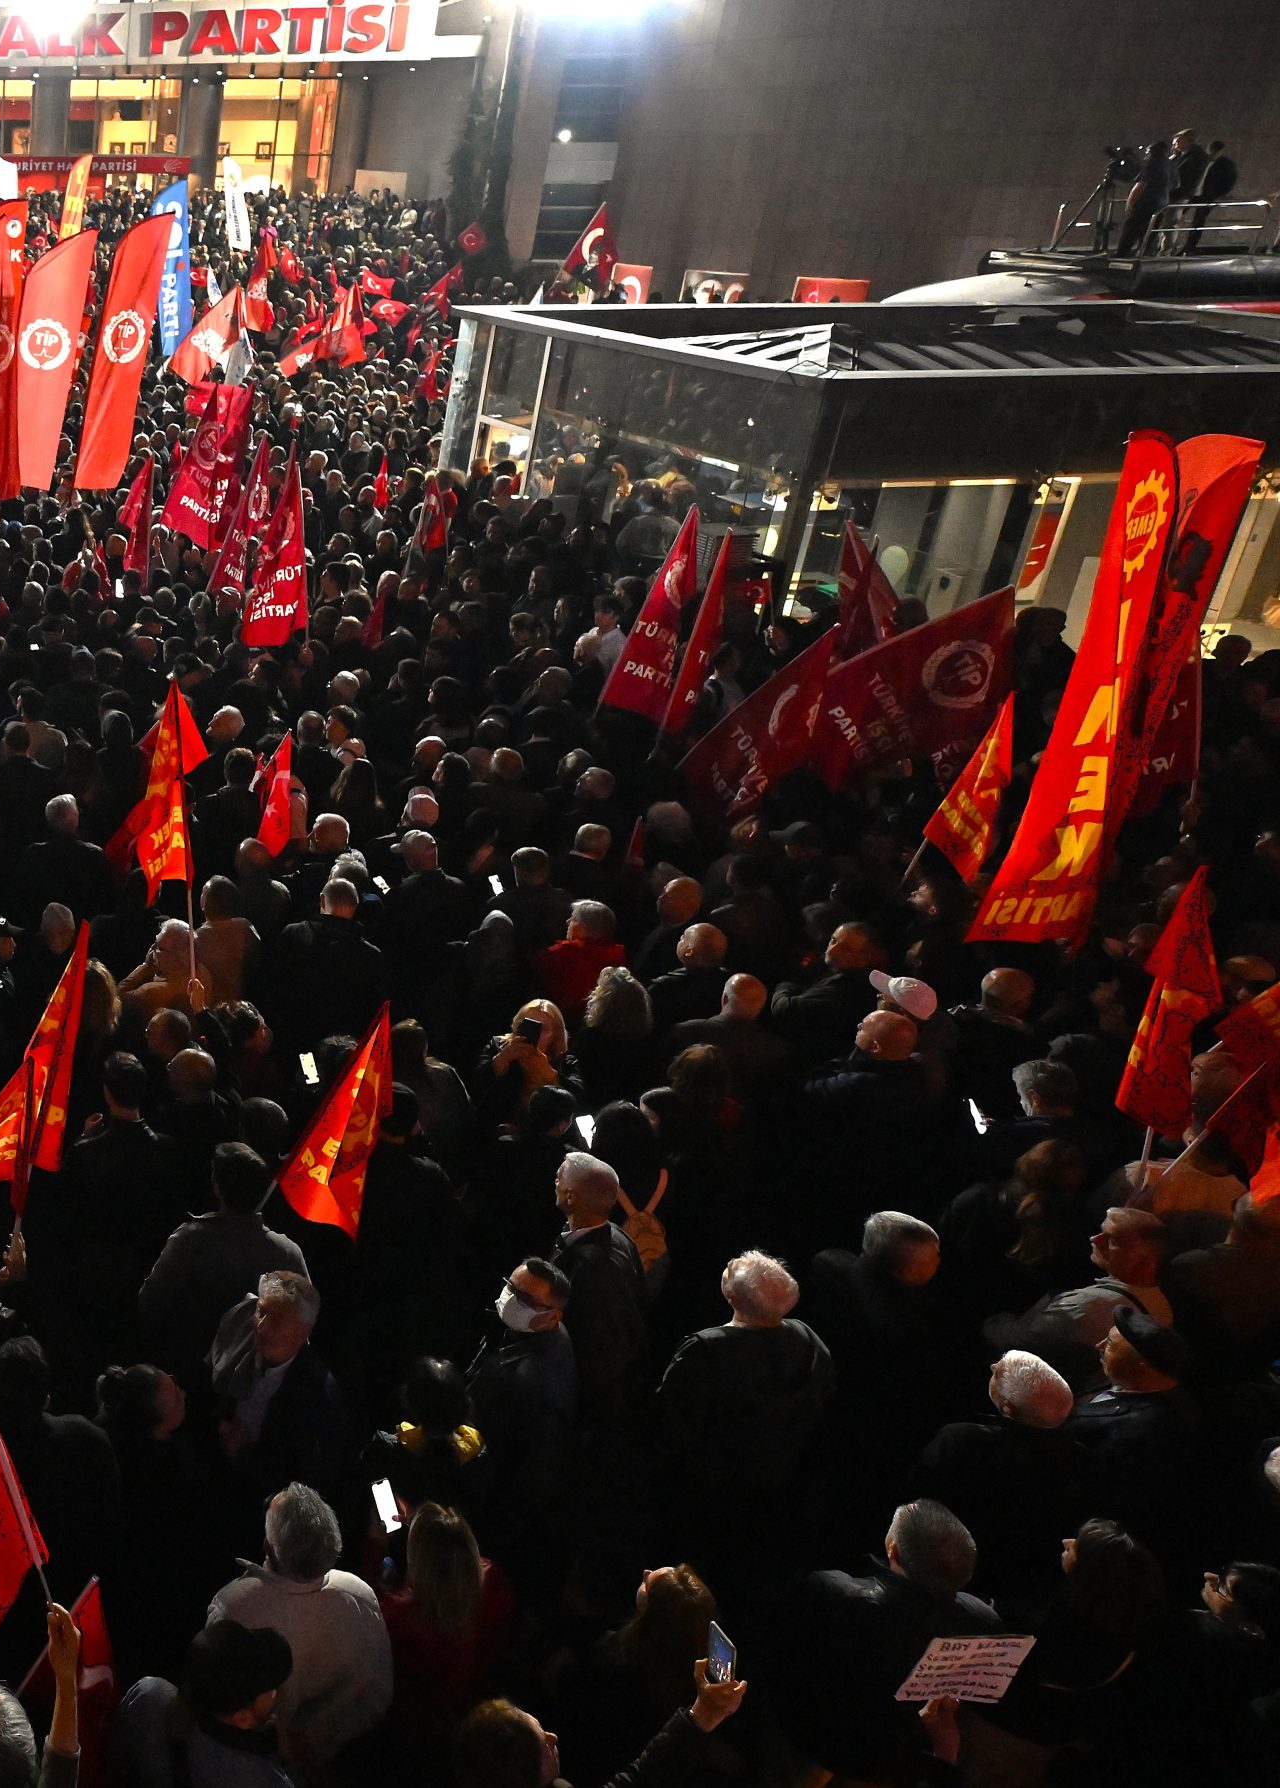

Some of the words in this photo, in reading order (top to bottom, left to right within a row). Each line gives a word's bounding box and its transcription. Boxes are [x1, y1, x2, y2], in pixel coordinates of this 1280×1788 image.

[149, 0, 410, 53] PARTİSİ
[92, 159, 137, 171] PARTİSİ
[161, 273, 179, 338] PARTİ
[34, 330, 59, 347] TİP
[117, 322, 136, 339] TİP
[180, 495, 210, 522] PARTİ
[624, 660, 671, 690] PARTİ
